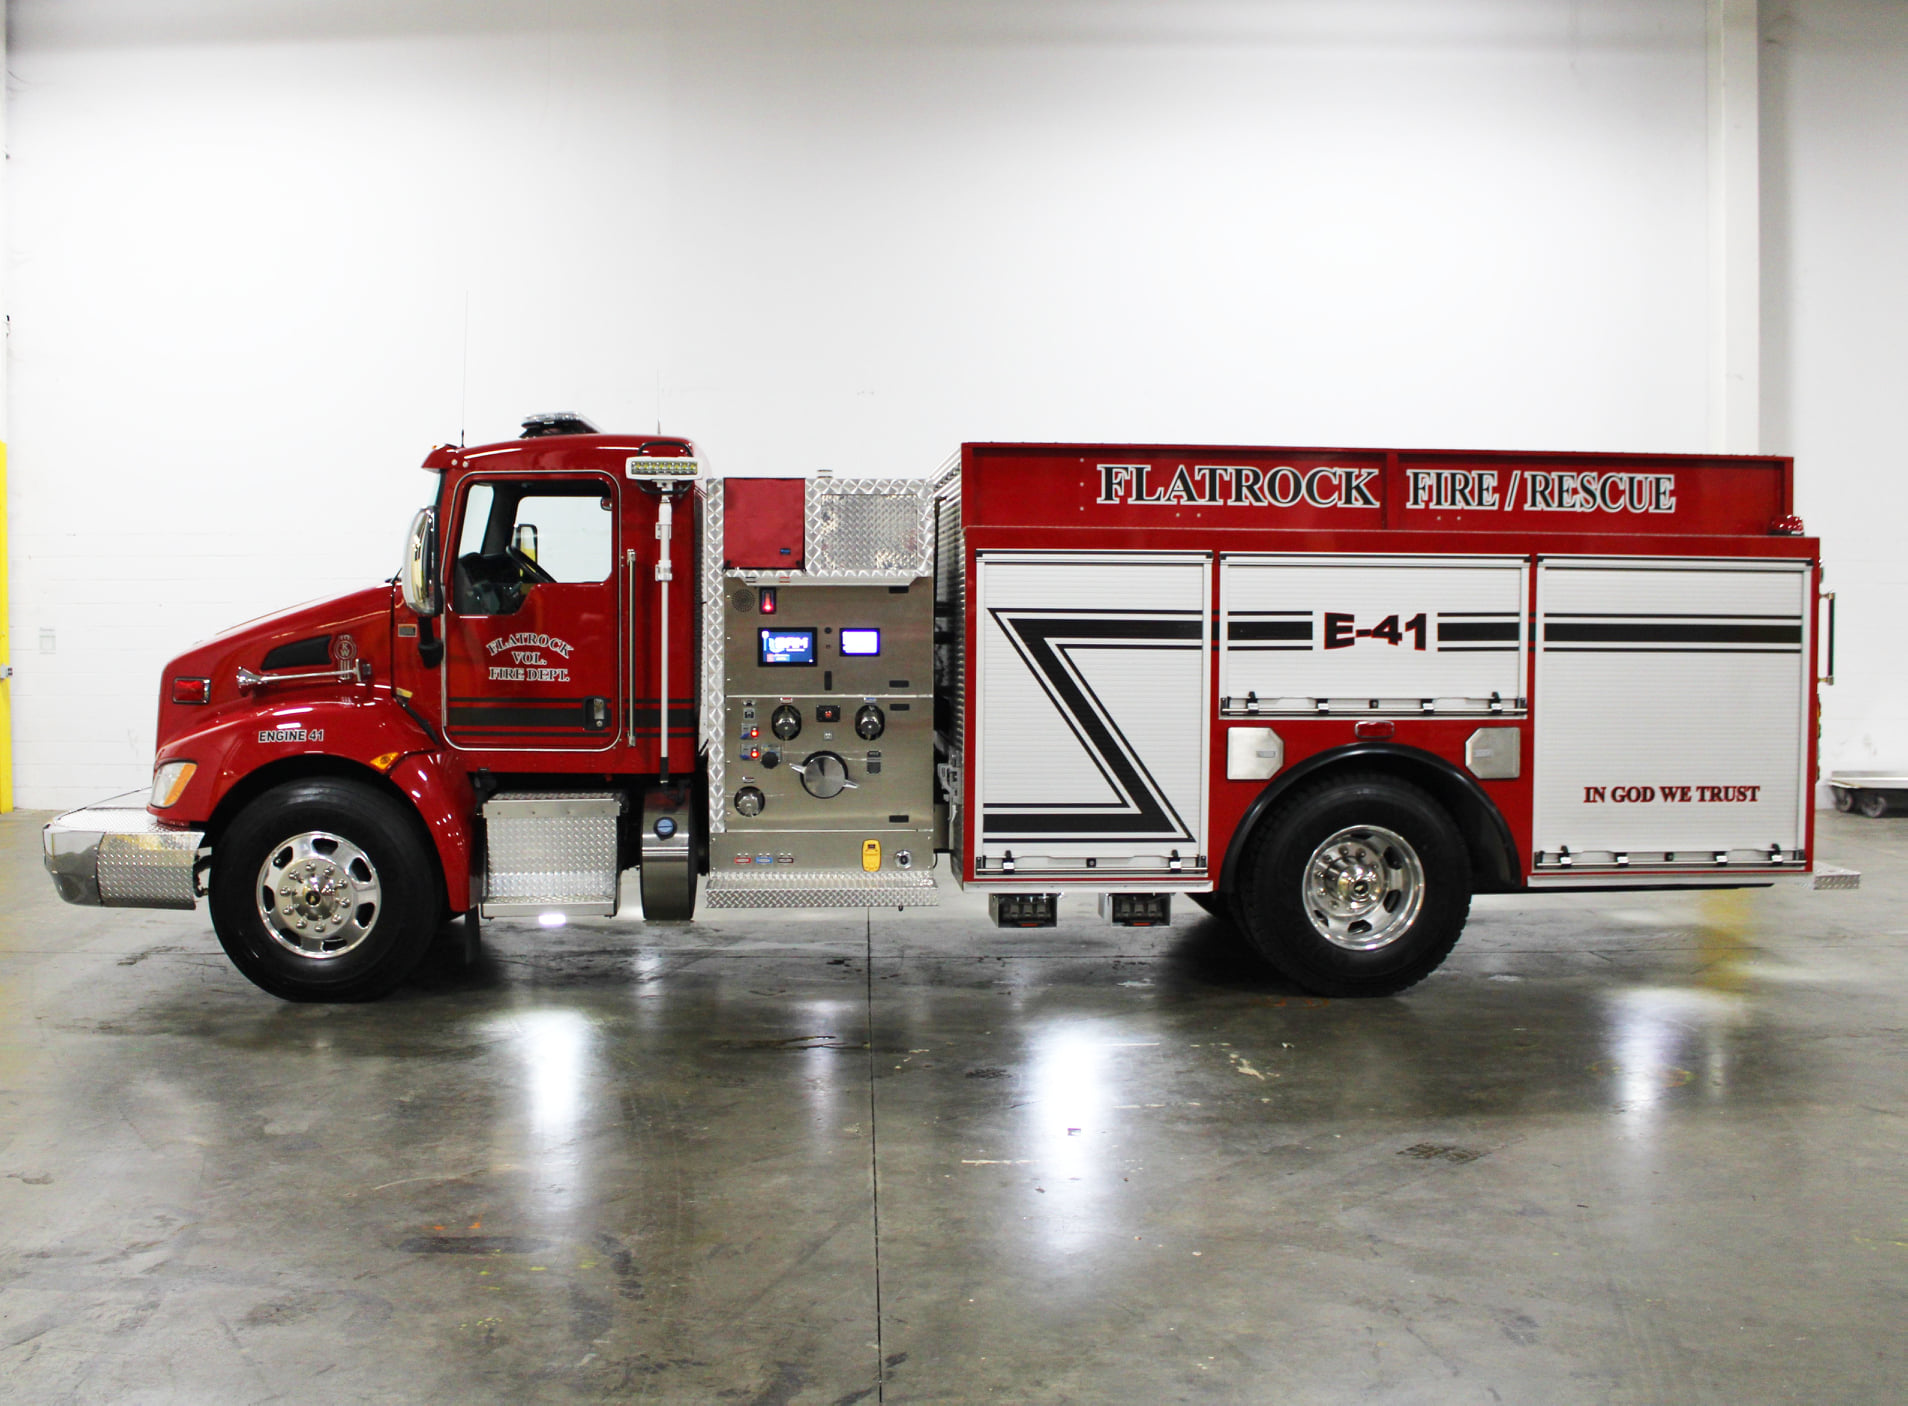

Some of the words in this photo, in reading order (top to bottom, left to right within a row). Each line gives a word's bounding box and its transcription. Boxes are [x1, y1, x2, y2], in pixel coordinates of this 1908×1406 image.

[1097, 464, 1381, 508] FLATROCK
[1324, 612, 1427, 651] E-41
[486, 632, 574, 659] FLATROCK
[511, 651, 548, 665] VOL.
[488, 667, 525, 681] FIRE
[526, 668, 570, 682] DEPT.
[258, 730, 307, 743] ENGINE
[308, 729, 324, 742] 41
[1584, 787, 1607, 803] IN
[1611, 786, 1655, 803] GOD
[1659, 786, 1692, 802] WE
[1696, 785, 1760, 802] TRUST
